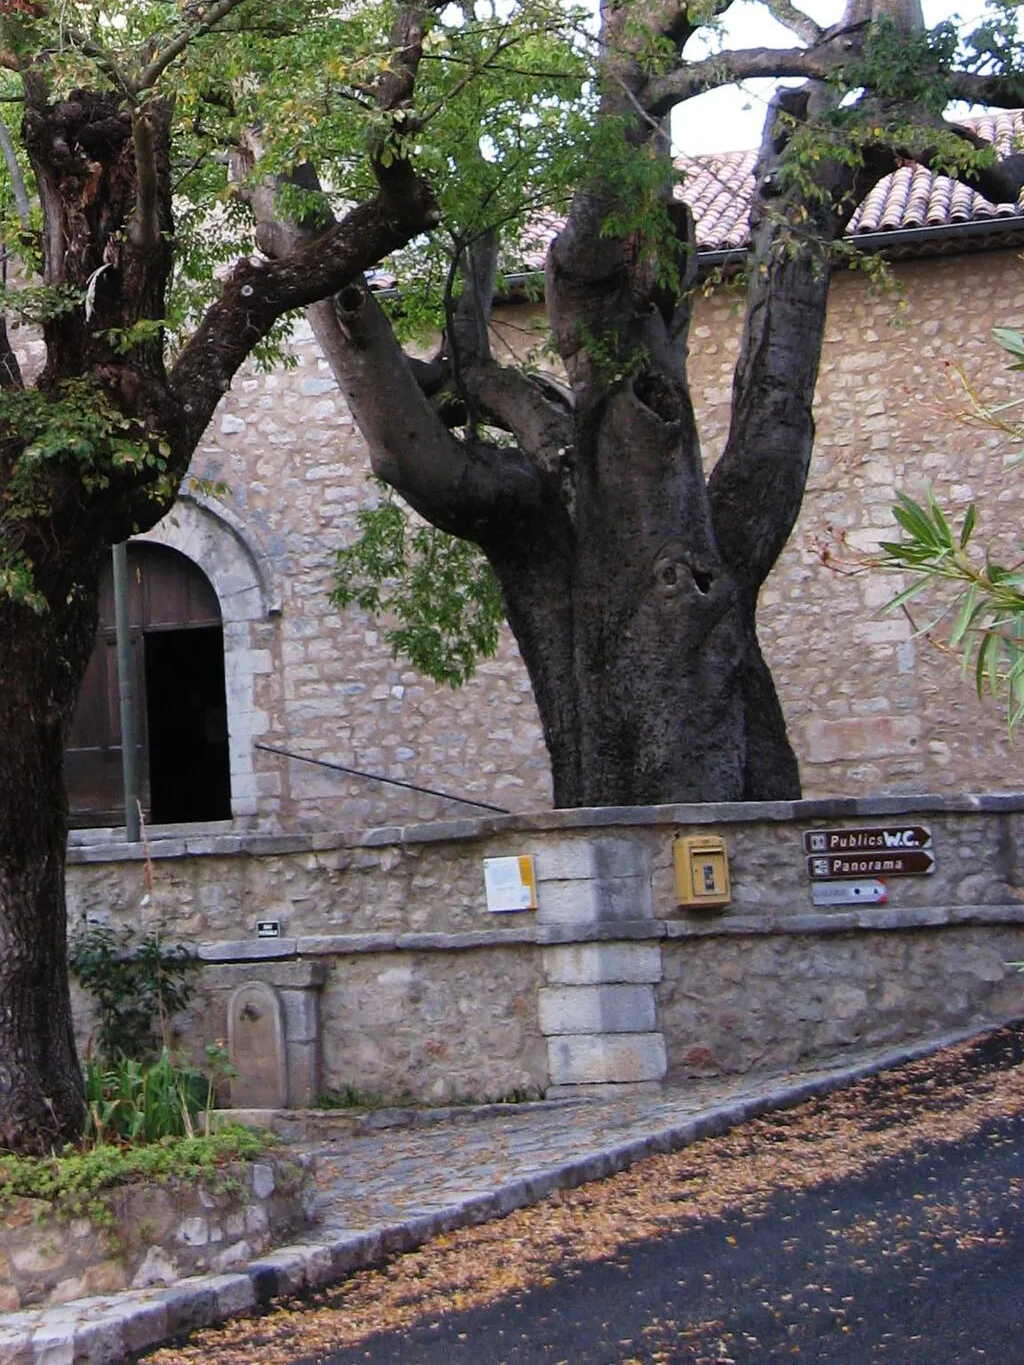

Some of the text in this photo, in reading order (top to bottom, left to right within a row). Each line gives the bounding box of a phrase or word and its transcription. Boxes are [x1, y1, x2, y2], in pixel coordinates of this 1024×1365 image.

[830, 830, 920, 848] Publics W.C.
[833, 859, 902, 872] Panorama
